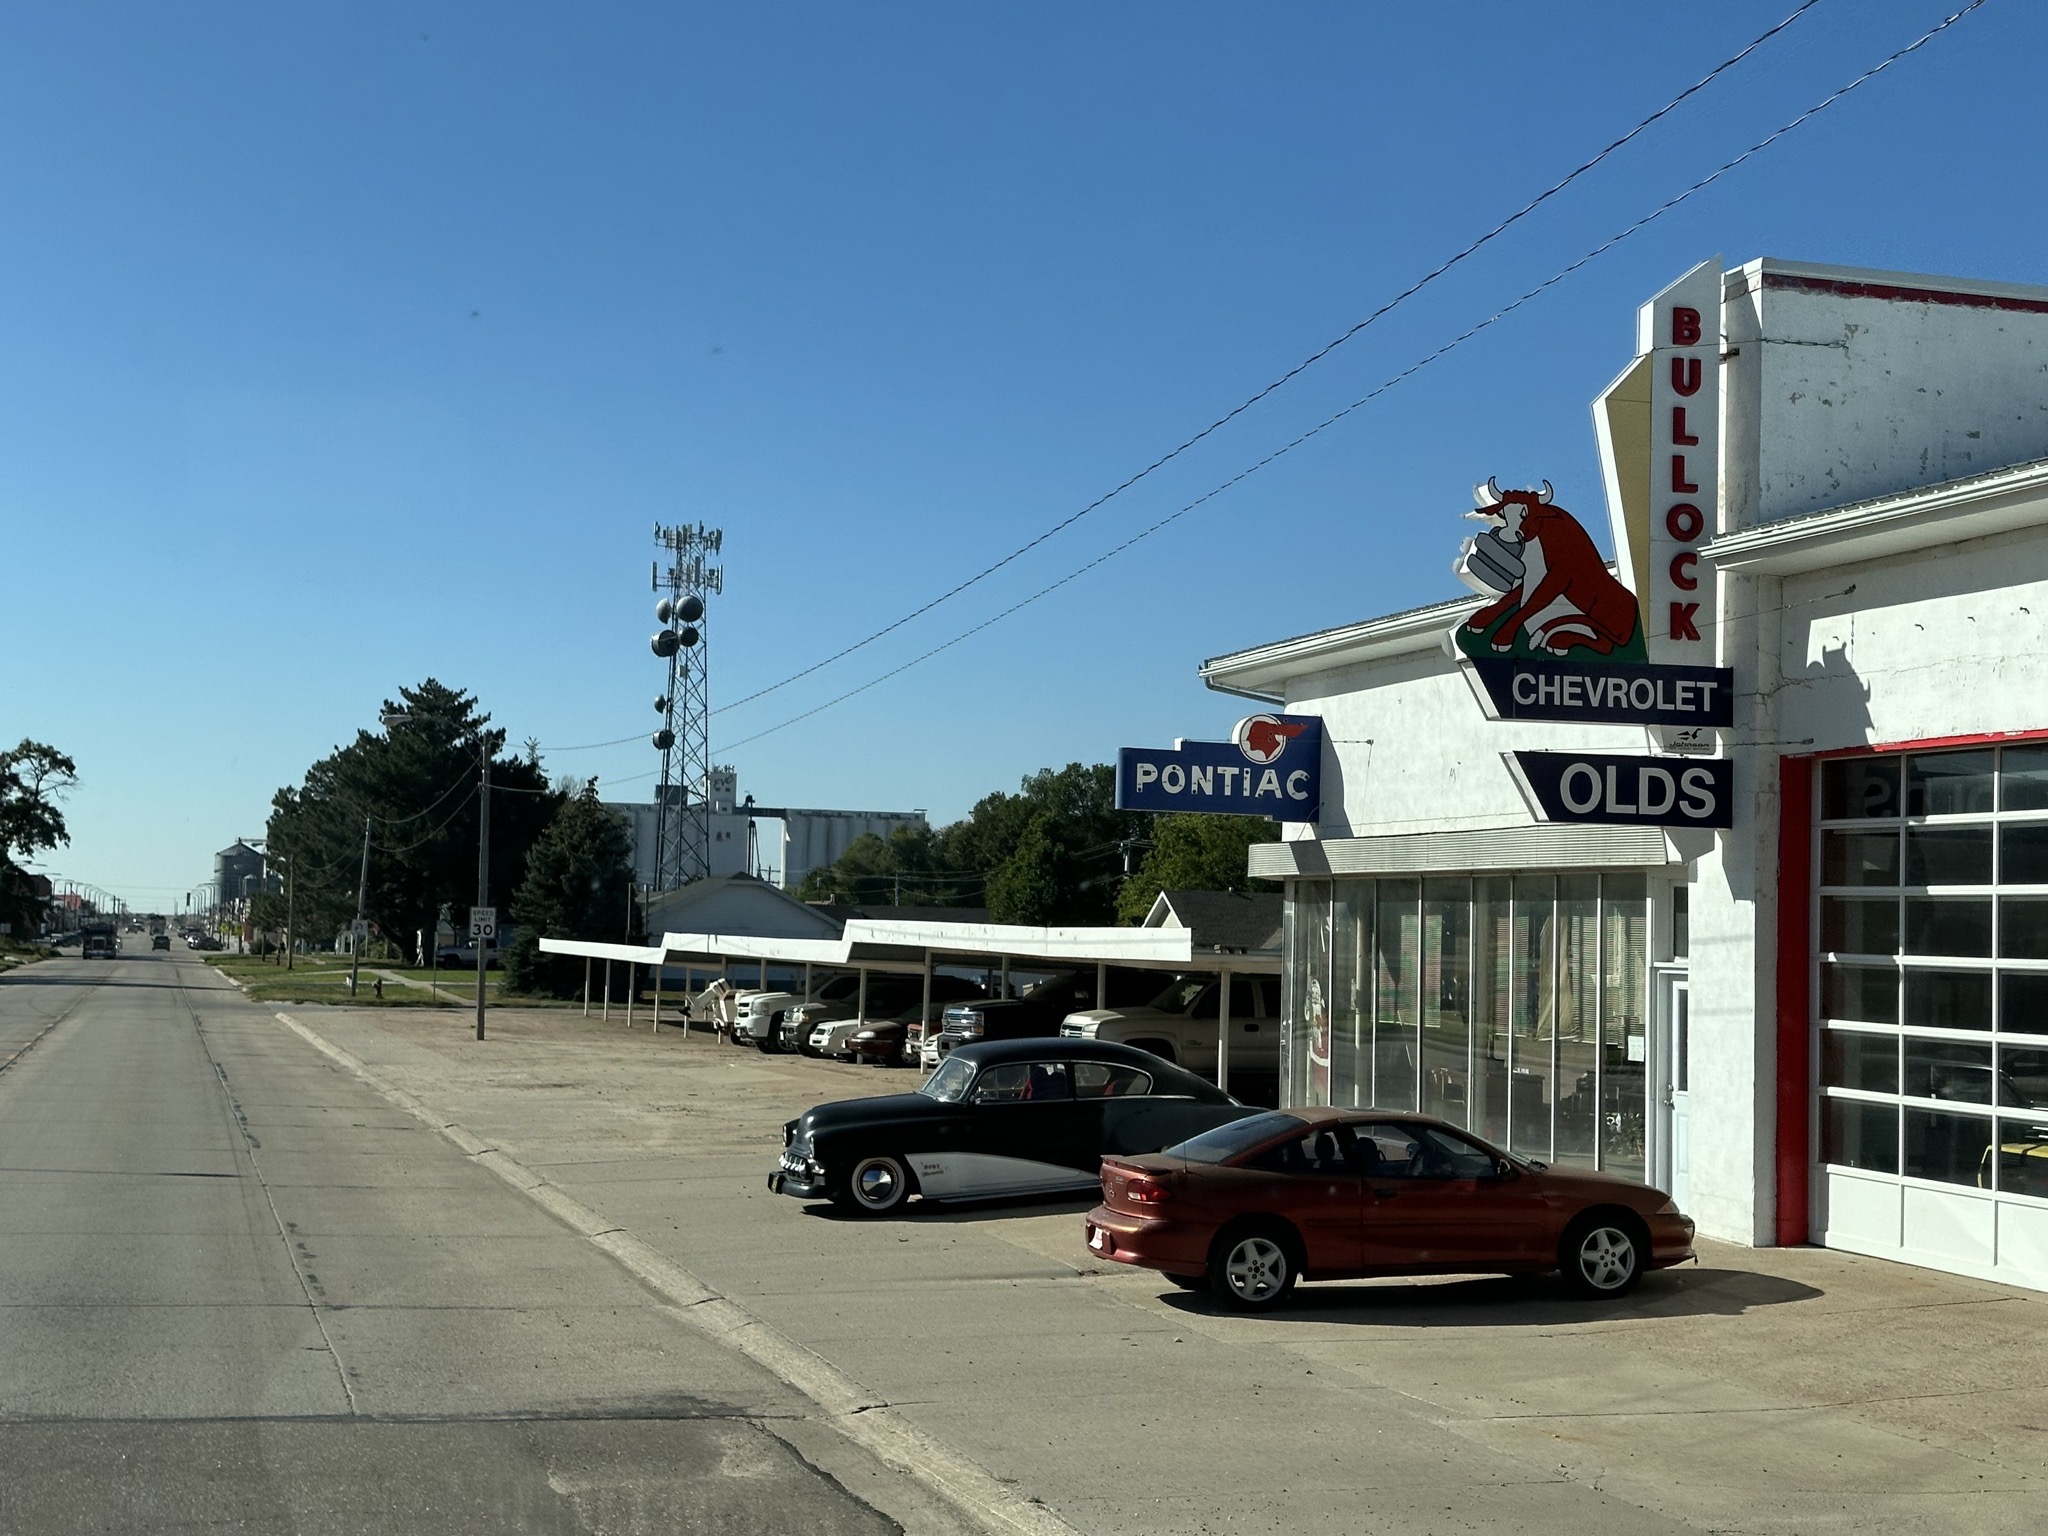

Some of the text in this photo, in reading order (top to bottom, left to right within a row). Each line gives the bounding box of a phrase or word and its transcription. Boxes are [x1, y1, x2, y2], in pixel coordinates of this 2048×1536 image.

[1666, 306, 1704, 642] BULLOCK
[1512, 673, 1718, 712] CHEVROLET
[1136, 762, 1311, 801] PONTIAC
[1559, 762, 1716, 818] OLDS
[472, 923, 493, 936] 30
